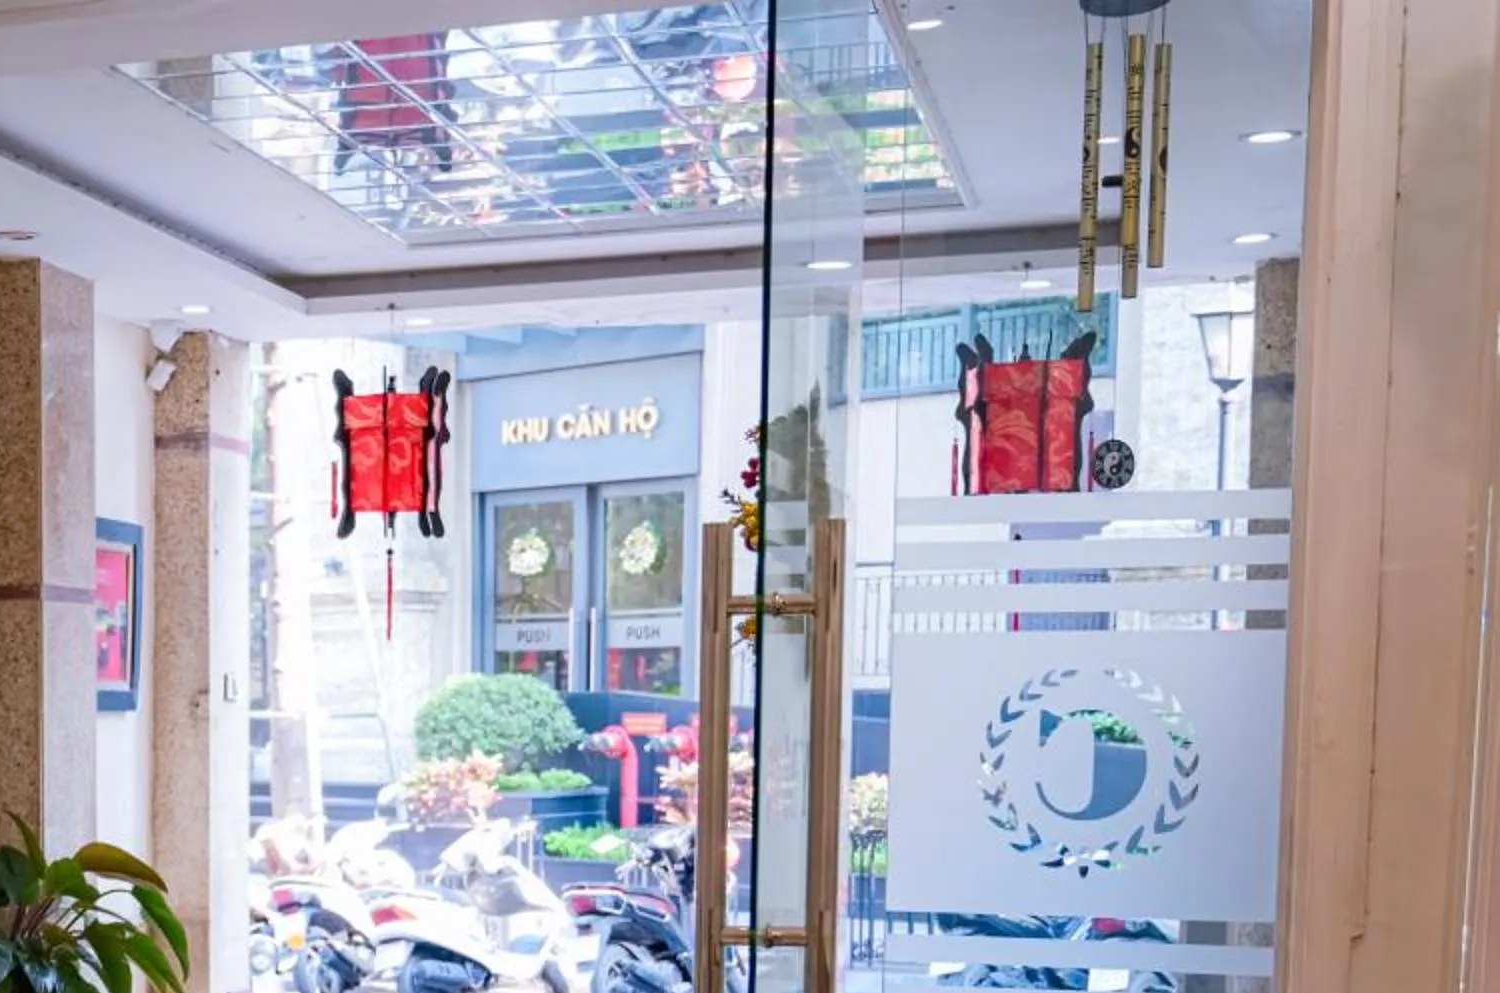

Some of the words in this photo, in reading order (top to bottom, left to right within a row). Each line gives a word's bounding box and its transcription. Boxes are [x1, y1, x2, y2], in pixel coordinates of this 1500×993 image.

[501, 416, 550, 445] KHU
[619, 396, 660, 440] HỘ
[626, 625, 661, 640] PUSH
